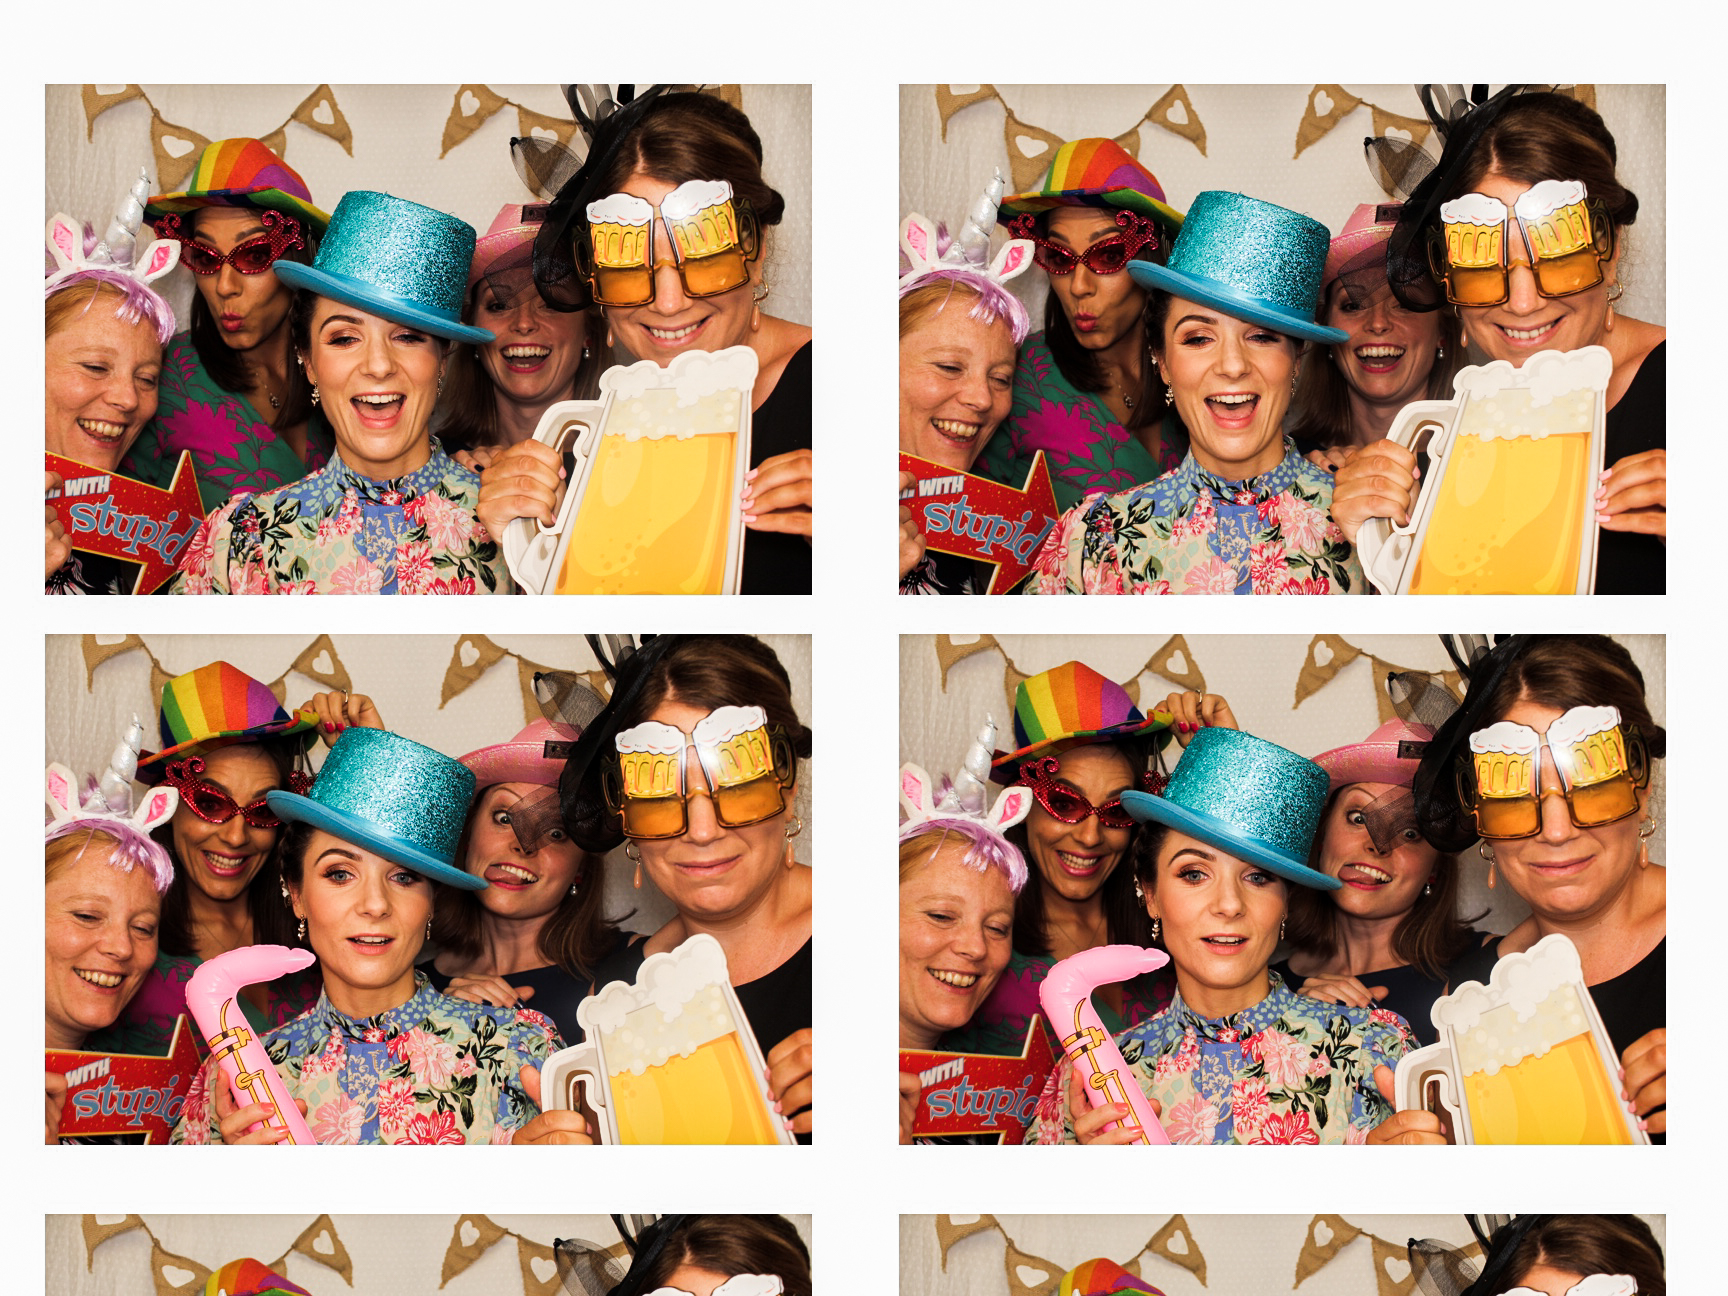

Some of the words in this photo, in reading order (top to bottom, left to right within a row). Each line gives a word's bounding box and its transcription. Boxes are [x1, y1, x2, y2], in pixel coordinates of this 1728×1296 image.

[64, 474, 111, 498] WITH
[918, 474, 965, 498] WITH
[69, 494, 204, 567] stupid
[923, 494, 1058, 567] stupid
[64, 1056, 111, 1089] WITH
[918, 1056, 965, 1089] WITH
